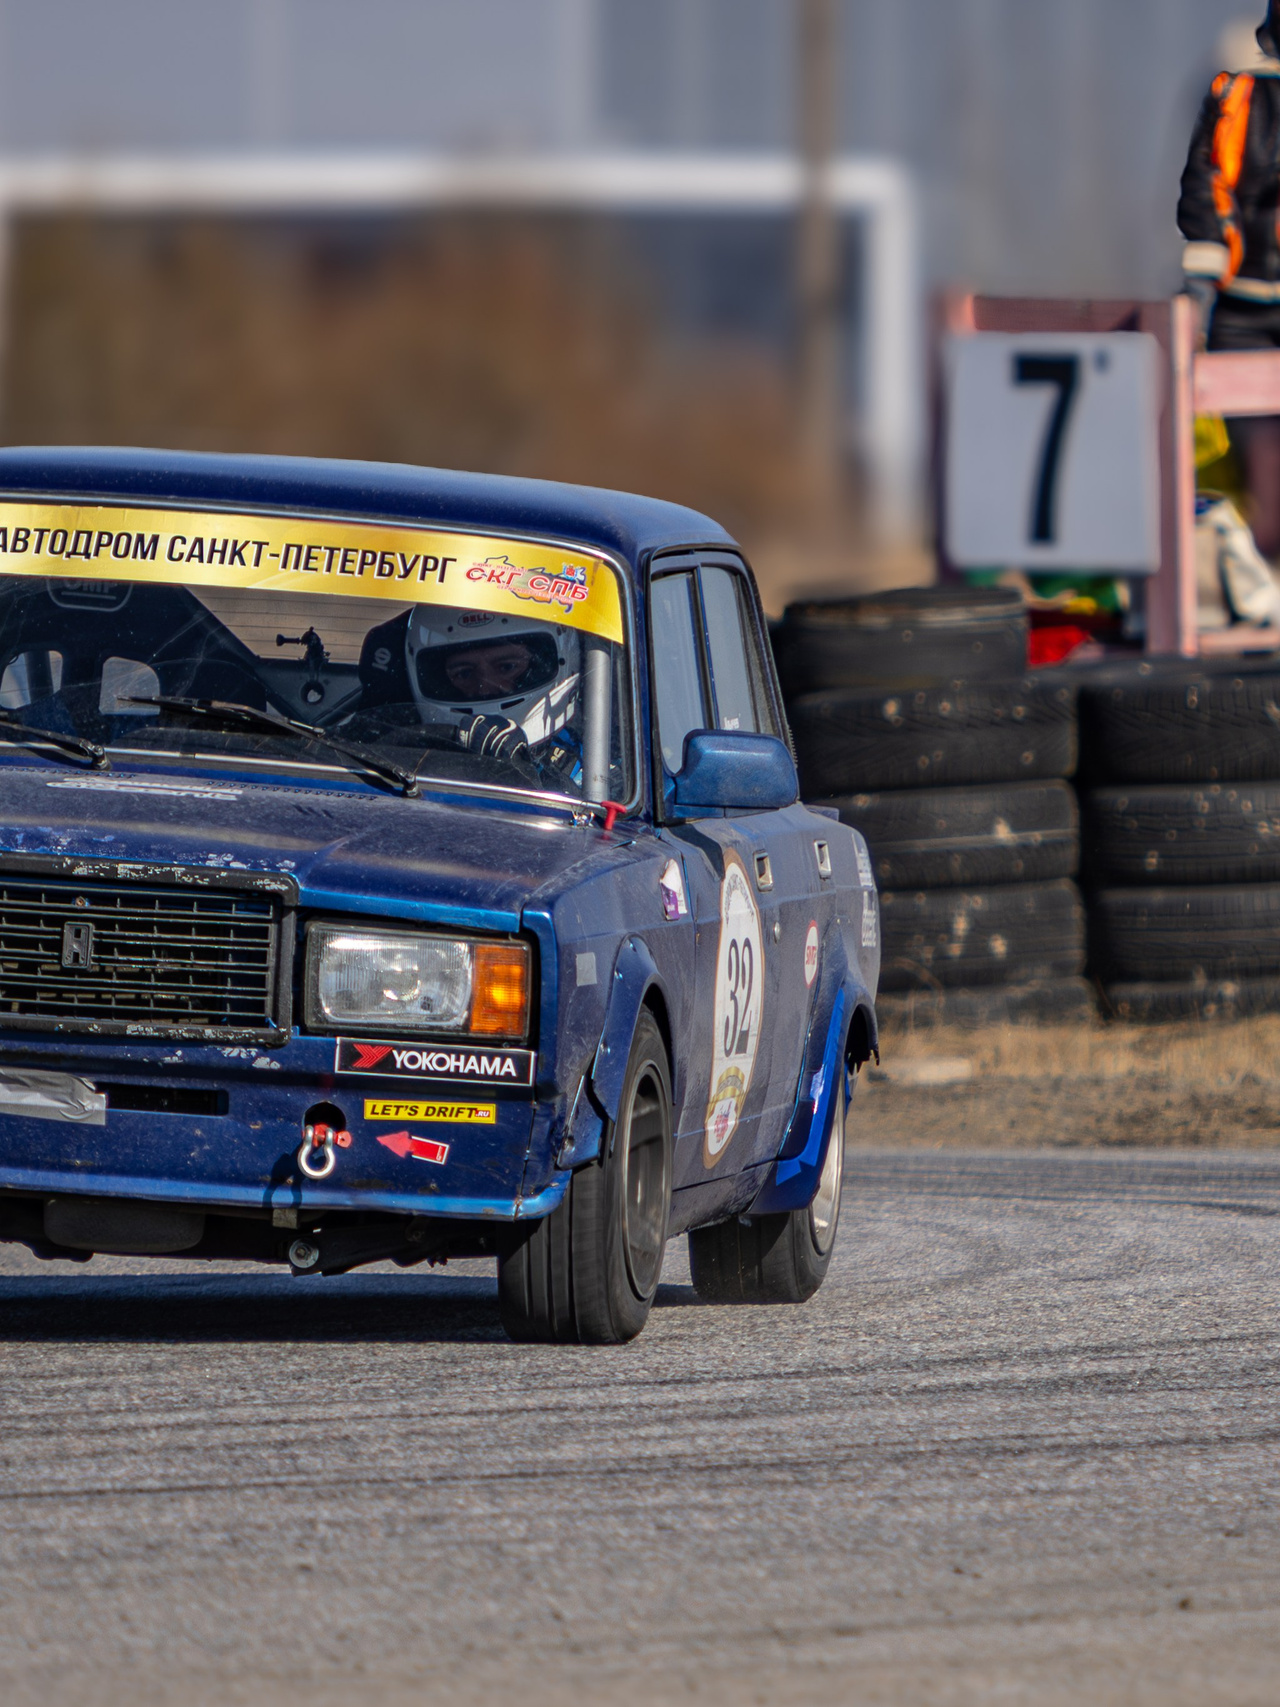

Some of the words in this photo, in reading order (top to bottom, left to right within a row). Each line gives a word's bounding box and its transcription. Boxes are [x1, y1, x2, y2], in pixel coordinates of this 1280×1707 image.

[1012, 351, 1081, 546] 7
[167, 534, 458, 584] САНКТ-ПЕТЕРБУРГ
[465, 566, 523, 586] СКГ
[527, 574, 589, 601] СПБ
[723, 937, 754, 1058] 32
[392, 1050, 517, 1077] YOKOHAMA
[370, 1104, 419, 1117] LET'S
